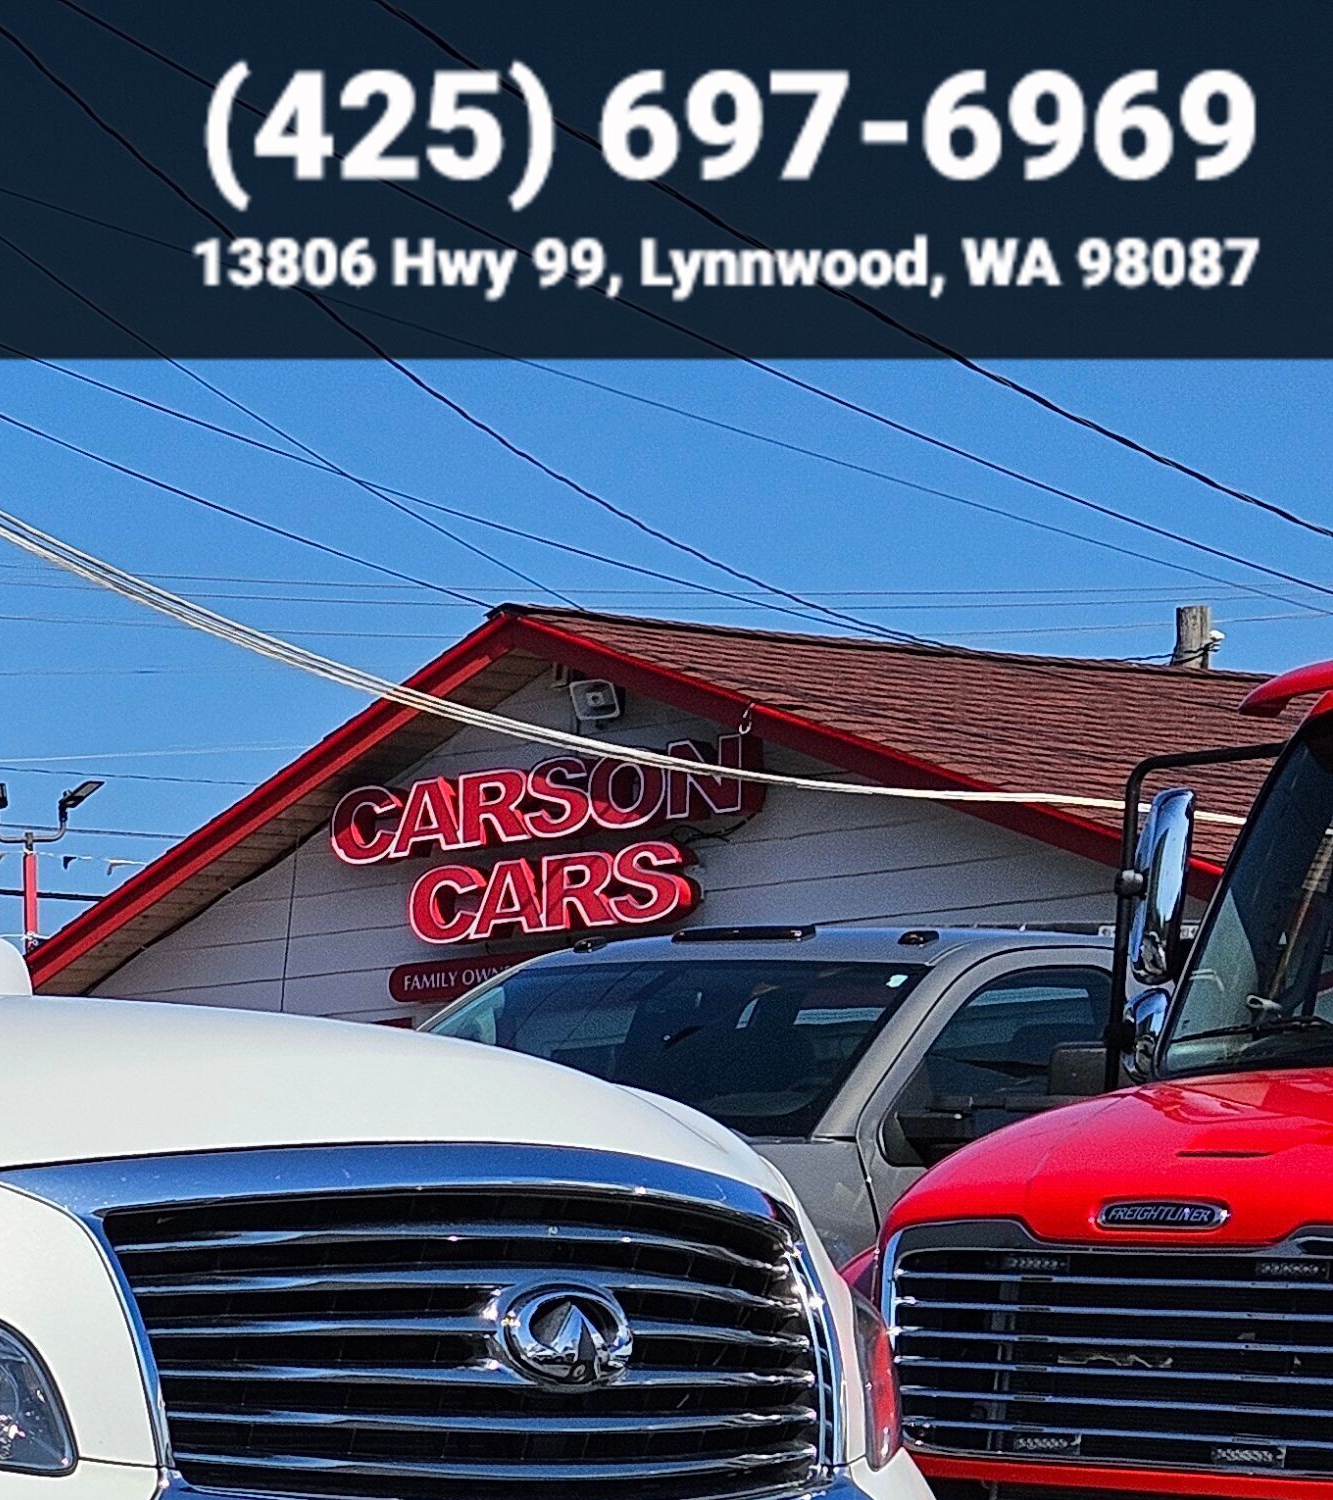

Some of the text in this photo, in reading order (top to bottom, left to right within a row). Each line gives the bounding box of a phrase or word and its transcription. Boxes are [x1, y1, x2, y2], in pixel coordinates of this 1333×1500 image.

[331, 734, 745, 865] CARSON
[410, 840, 695, 945] CARS
[404, 970, 458, 992] FAMILY
[1108, 1205, 1212, 1222] FREIGHTLINER
